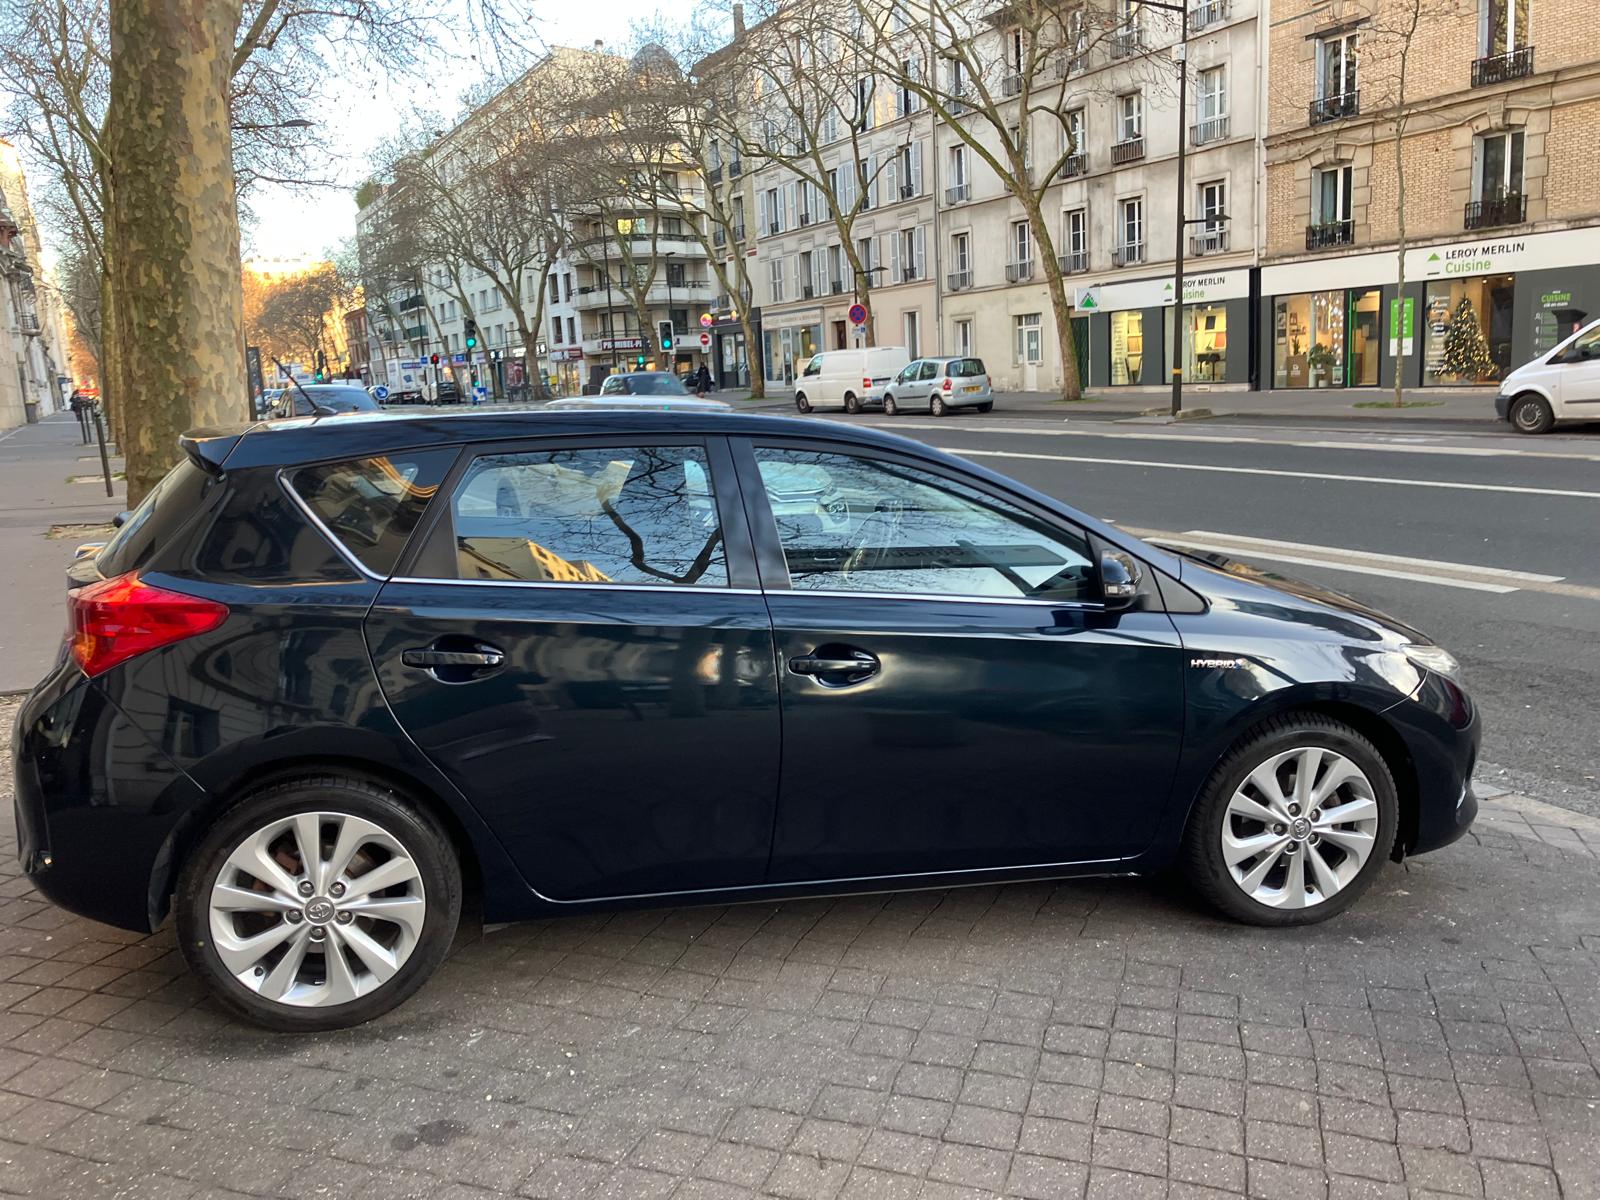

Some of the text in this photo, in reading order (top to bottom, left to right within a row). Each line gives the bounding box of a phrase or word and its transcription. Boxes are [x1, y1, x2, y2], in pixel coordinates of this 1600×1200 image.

[1445, 242, 1525, 260] LEROY MERLIN
[1445, 260, 1491, 274] Cuisine
[1182, 276, 1226, 288] ROY MERLIN
[1541, 292, 1572, 303] CUISINE
[1190, 659, 1235, 668] HYBRID
